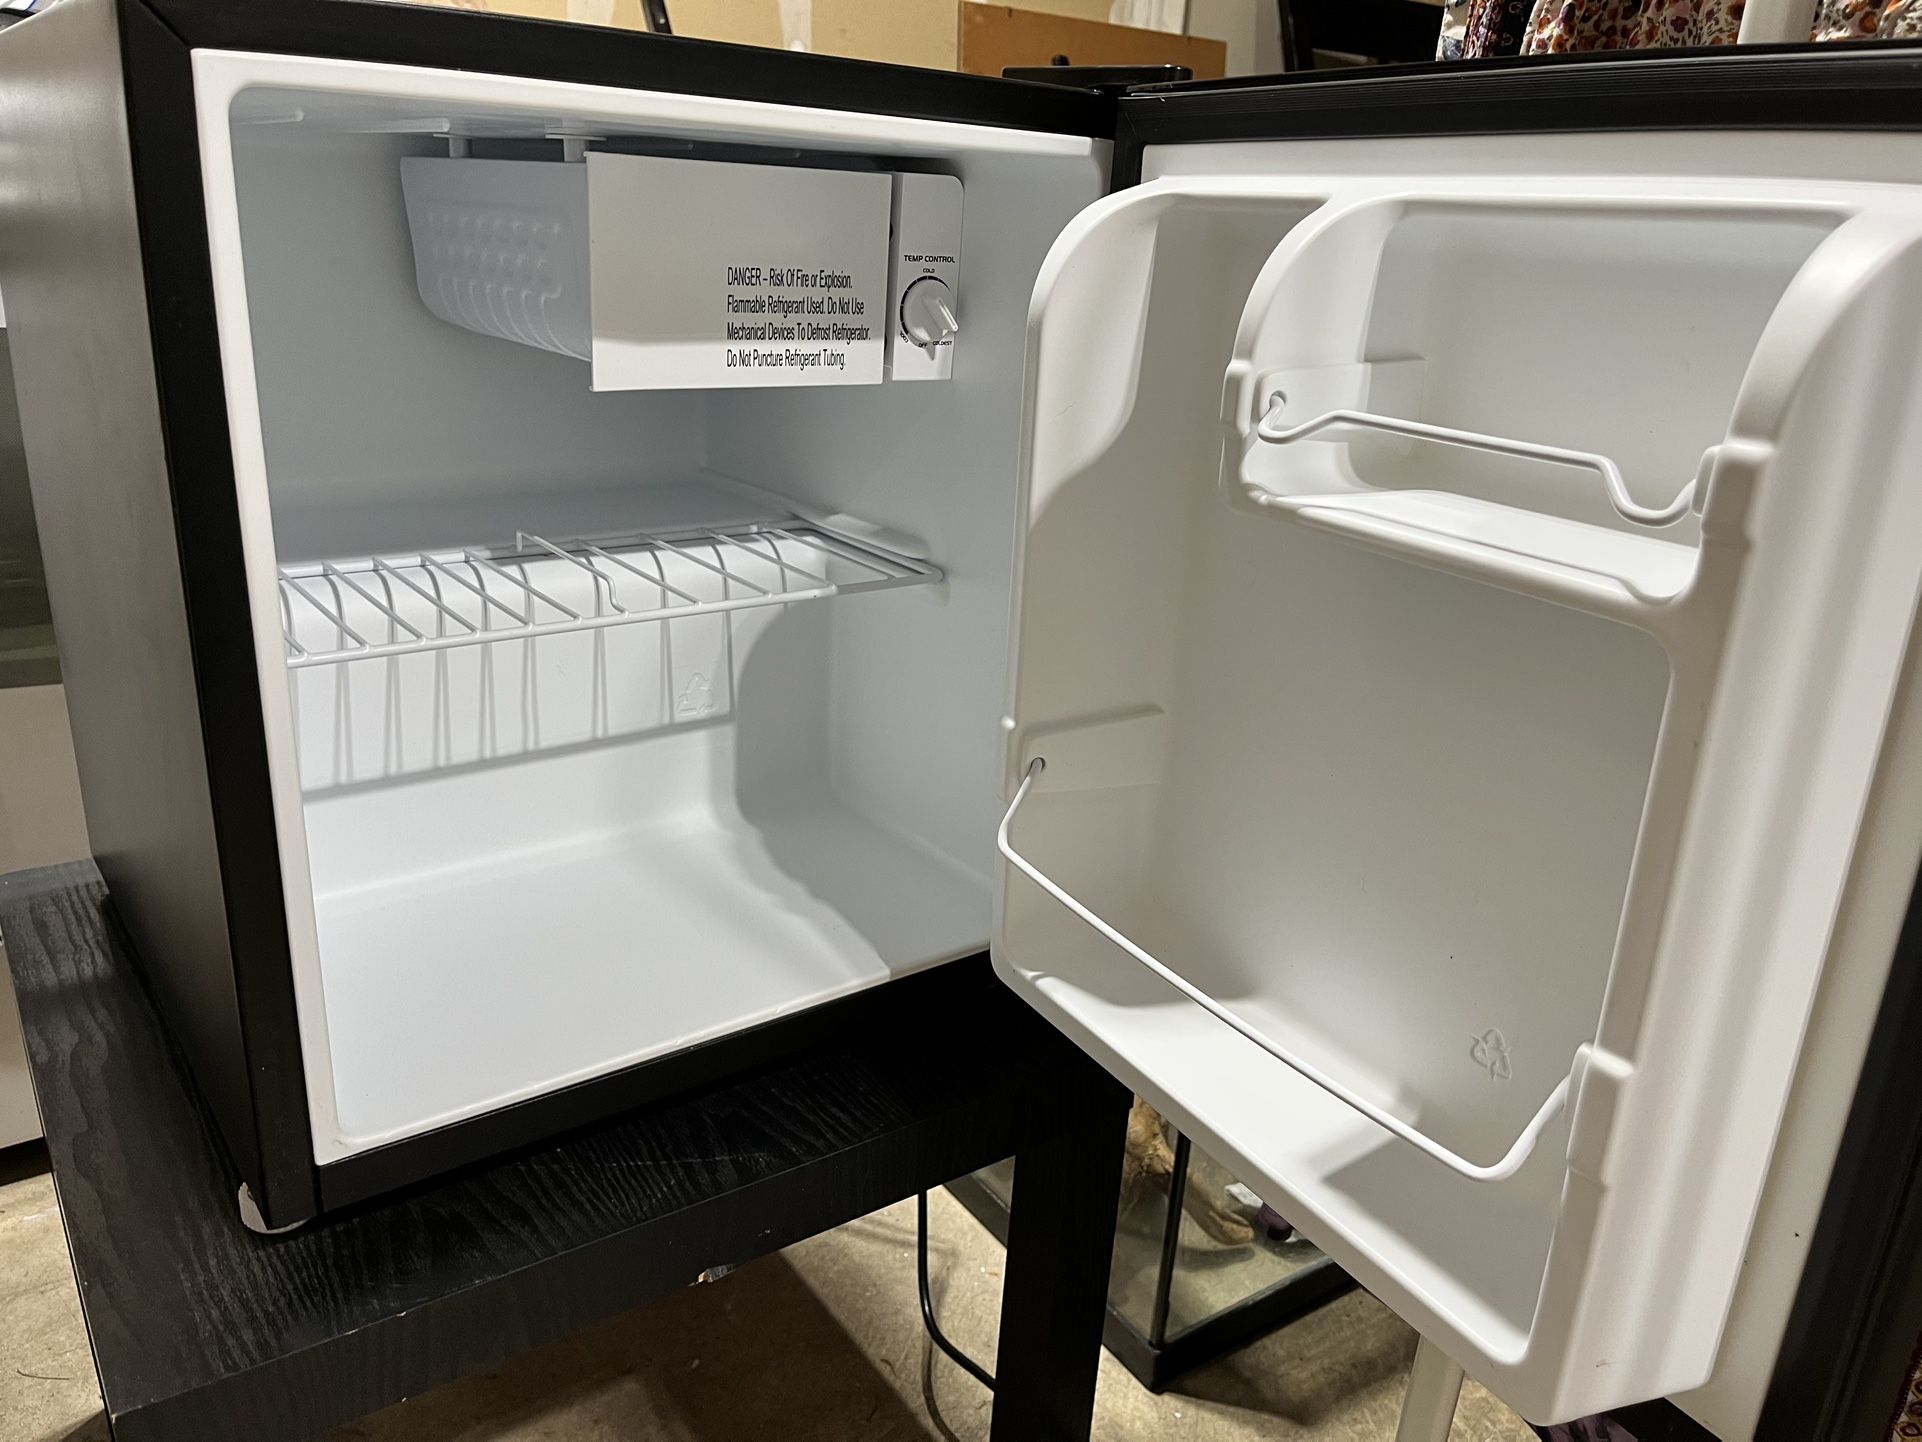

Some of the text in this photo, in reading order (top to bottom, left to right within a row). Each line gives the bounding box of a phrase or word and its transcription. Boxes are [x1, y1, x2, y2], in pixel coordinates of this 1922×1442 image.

[903, 254, 956, 264] TEMP CONTROL
[727, 266, 762, 286] DANGER
[769, 268, 785, 287] Risk
[786, 268, 796, 287] Of
[796, 268, 810, 287] Fire
[810, 273, 819, 288] or
[819, 269, 853, 293] Explosion.
[727, 294, 766, 314] Flammable
[767, 295, 806, 318] Refrigerant
[827, 296, 837, 315] Do
[838, 296, 850, 315] Not
[851, 297, 865, 315] Use
[726, 322, 871, 345] Mechanical Devices To Defrost Refrigerator.
[726, 348, 738, 367] Do
[738, 348, 752, 367] Not
[752, 348, 784, 367] Puncture
[784, 348, 822, 371] Refrigerant
